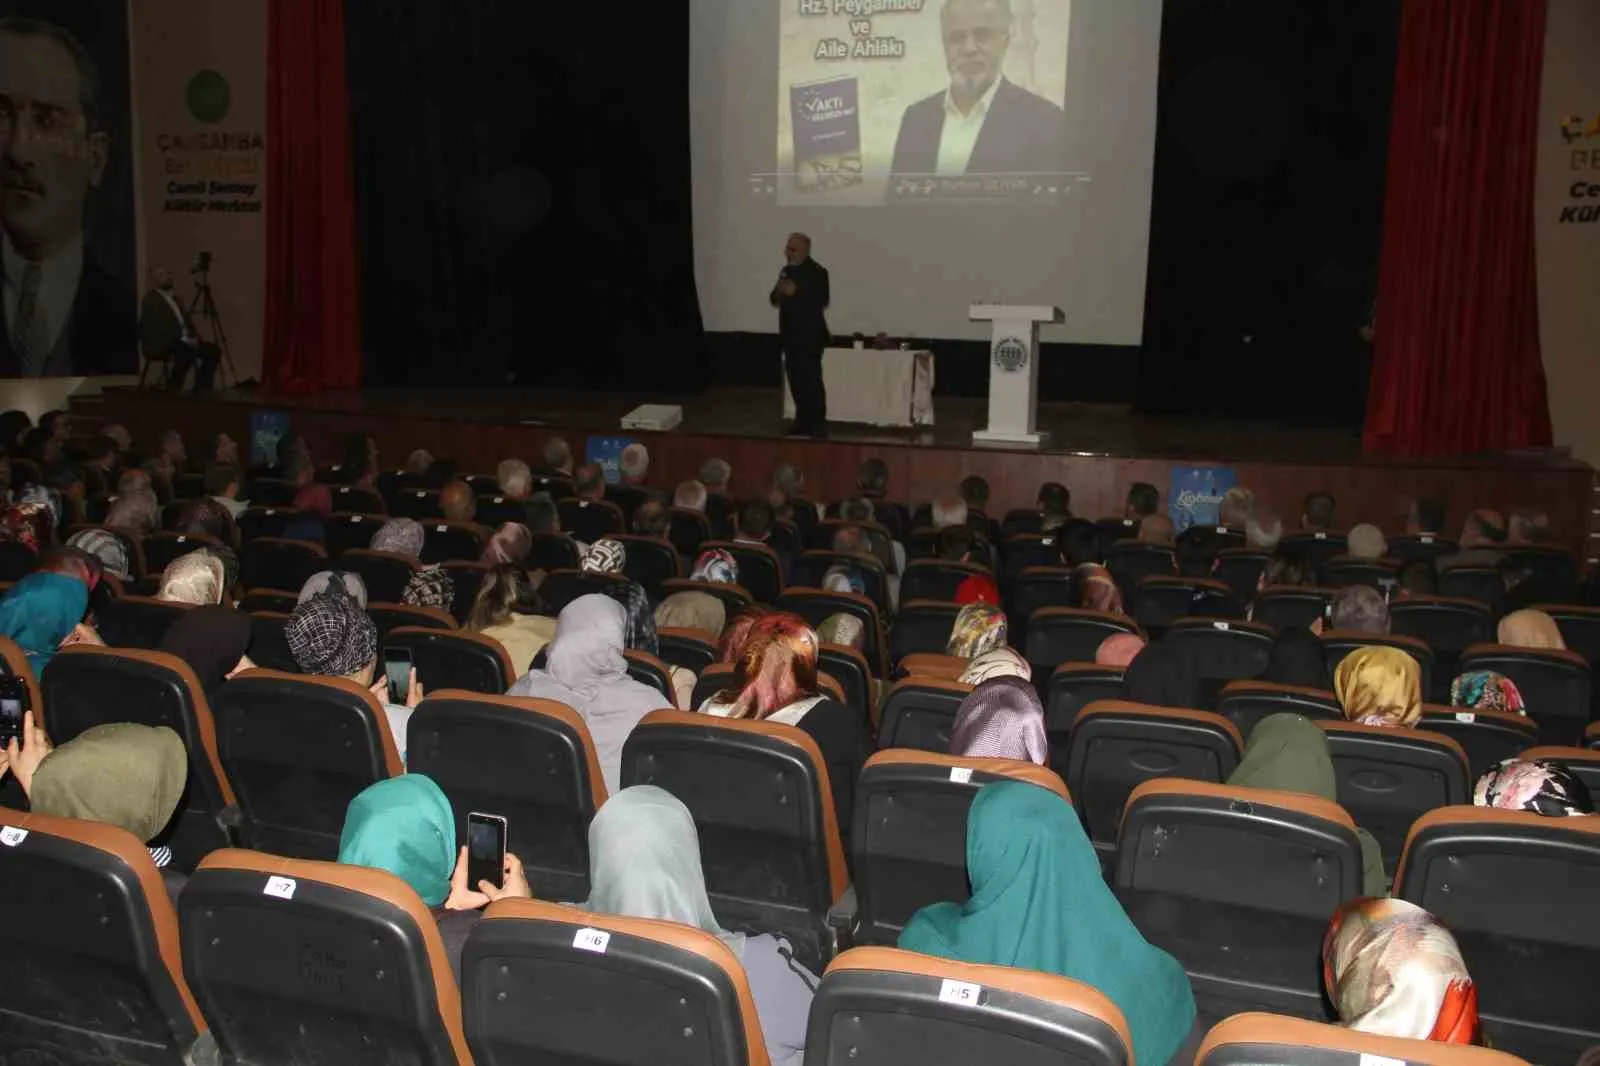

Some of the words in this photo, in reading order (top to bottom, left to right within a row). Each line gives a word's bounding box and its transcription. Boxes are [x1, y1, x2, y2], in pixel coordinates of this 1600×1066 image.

[834, 0, 922, 16] Peygamber
[849, 21, 870, 35] ve
[816, 39, 848, 58] Aile
[274, 882, 291, 893] H7
[585, 932, 603, 946] H6
[949, 986, 969, 1000] H5
